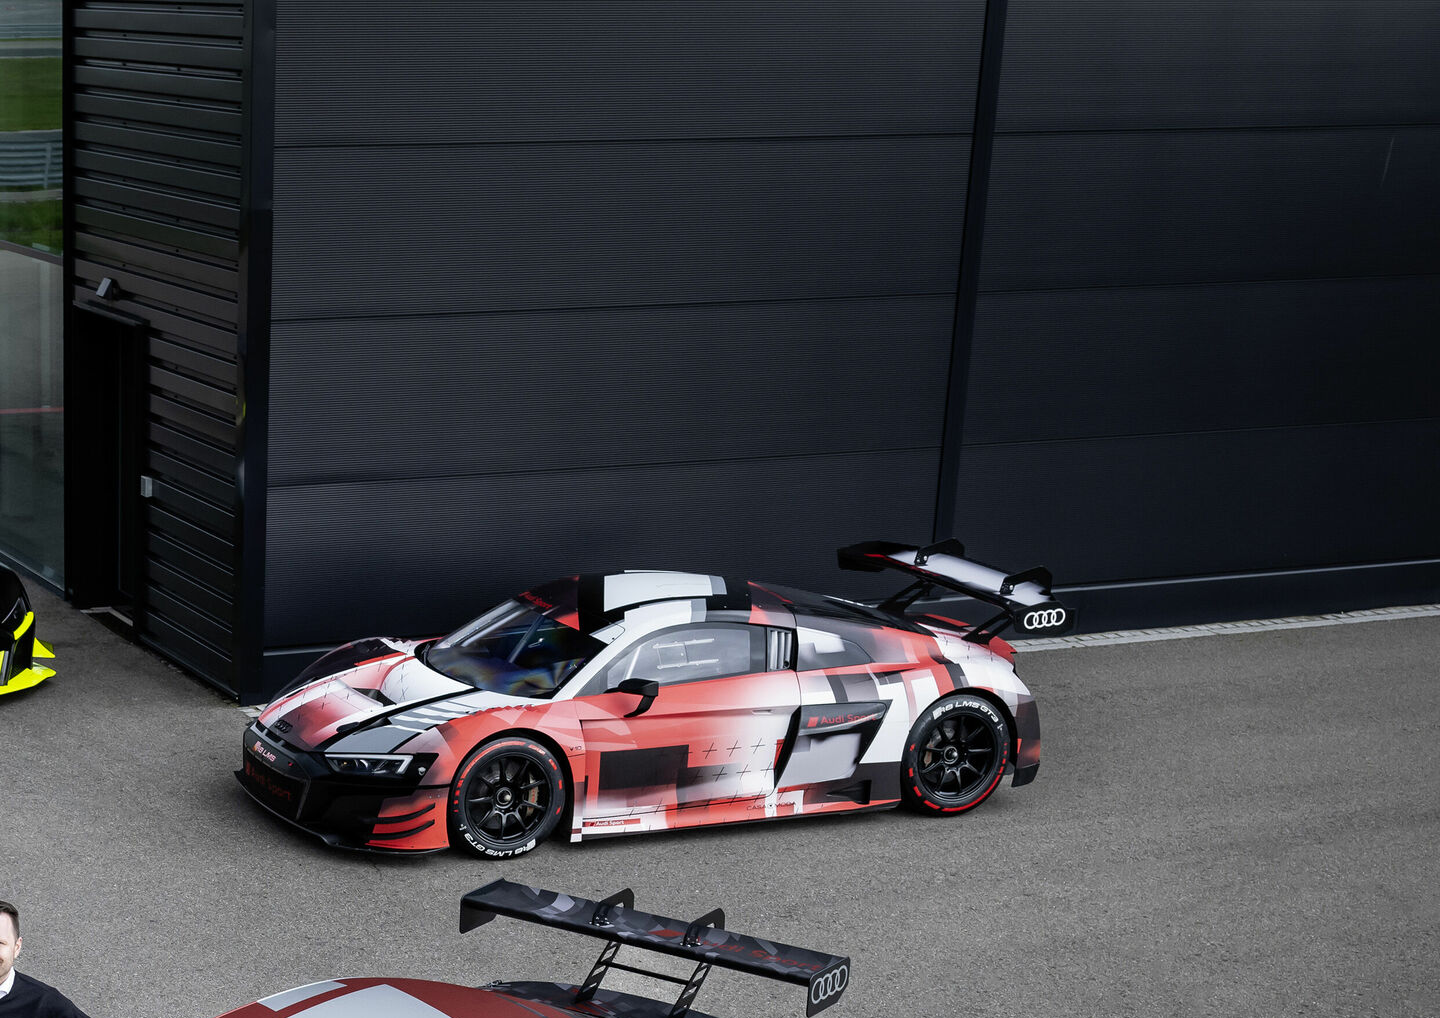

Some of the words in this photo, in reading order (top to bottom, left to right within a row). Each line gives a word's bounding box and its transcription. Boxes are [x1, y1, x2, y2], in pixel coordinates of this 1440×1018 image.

[955, 701, 980, 709] LMS
[980, 705, 999, 723] GT3
[821, 715, 845, 725] Audi
[262, 749, 277, 762] LMS
[609, 819, 625, 827] Sport
[464, 833, 486, 852] GT3
[485, 848, 513, 857] LMS
[697, 936, 745, 953] udi
[748, 949, 824, 971] Sport
